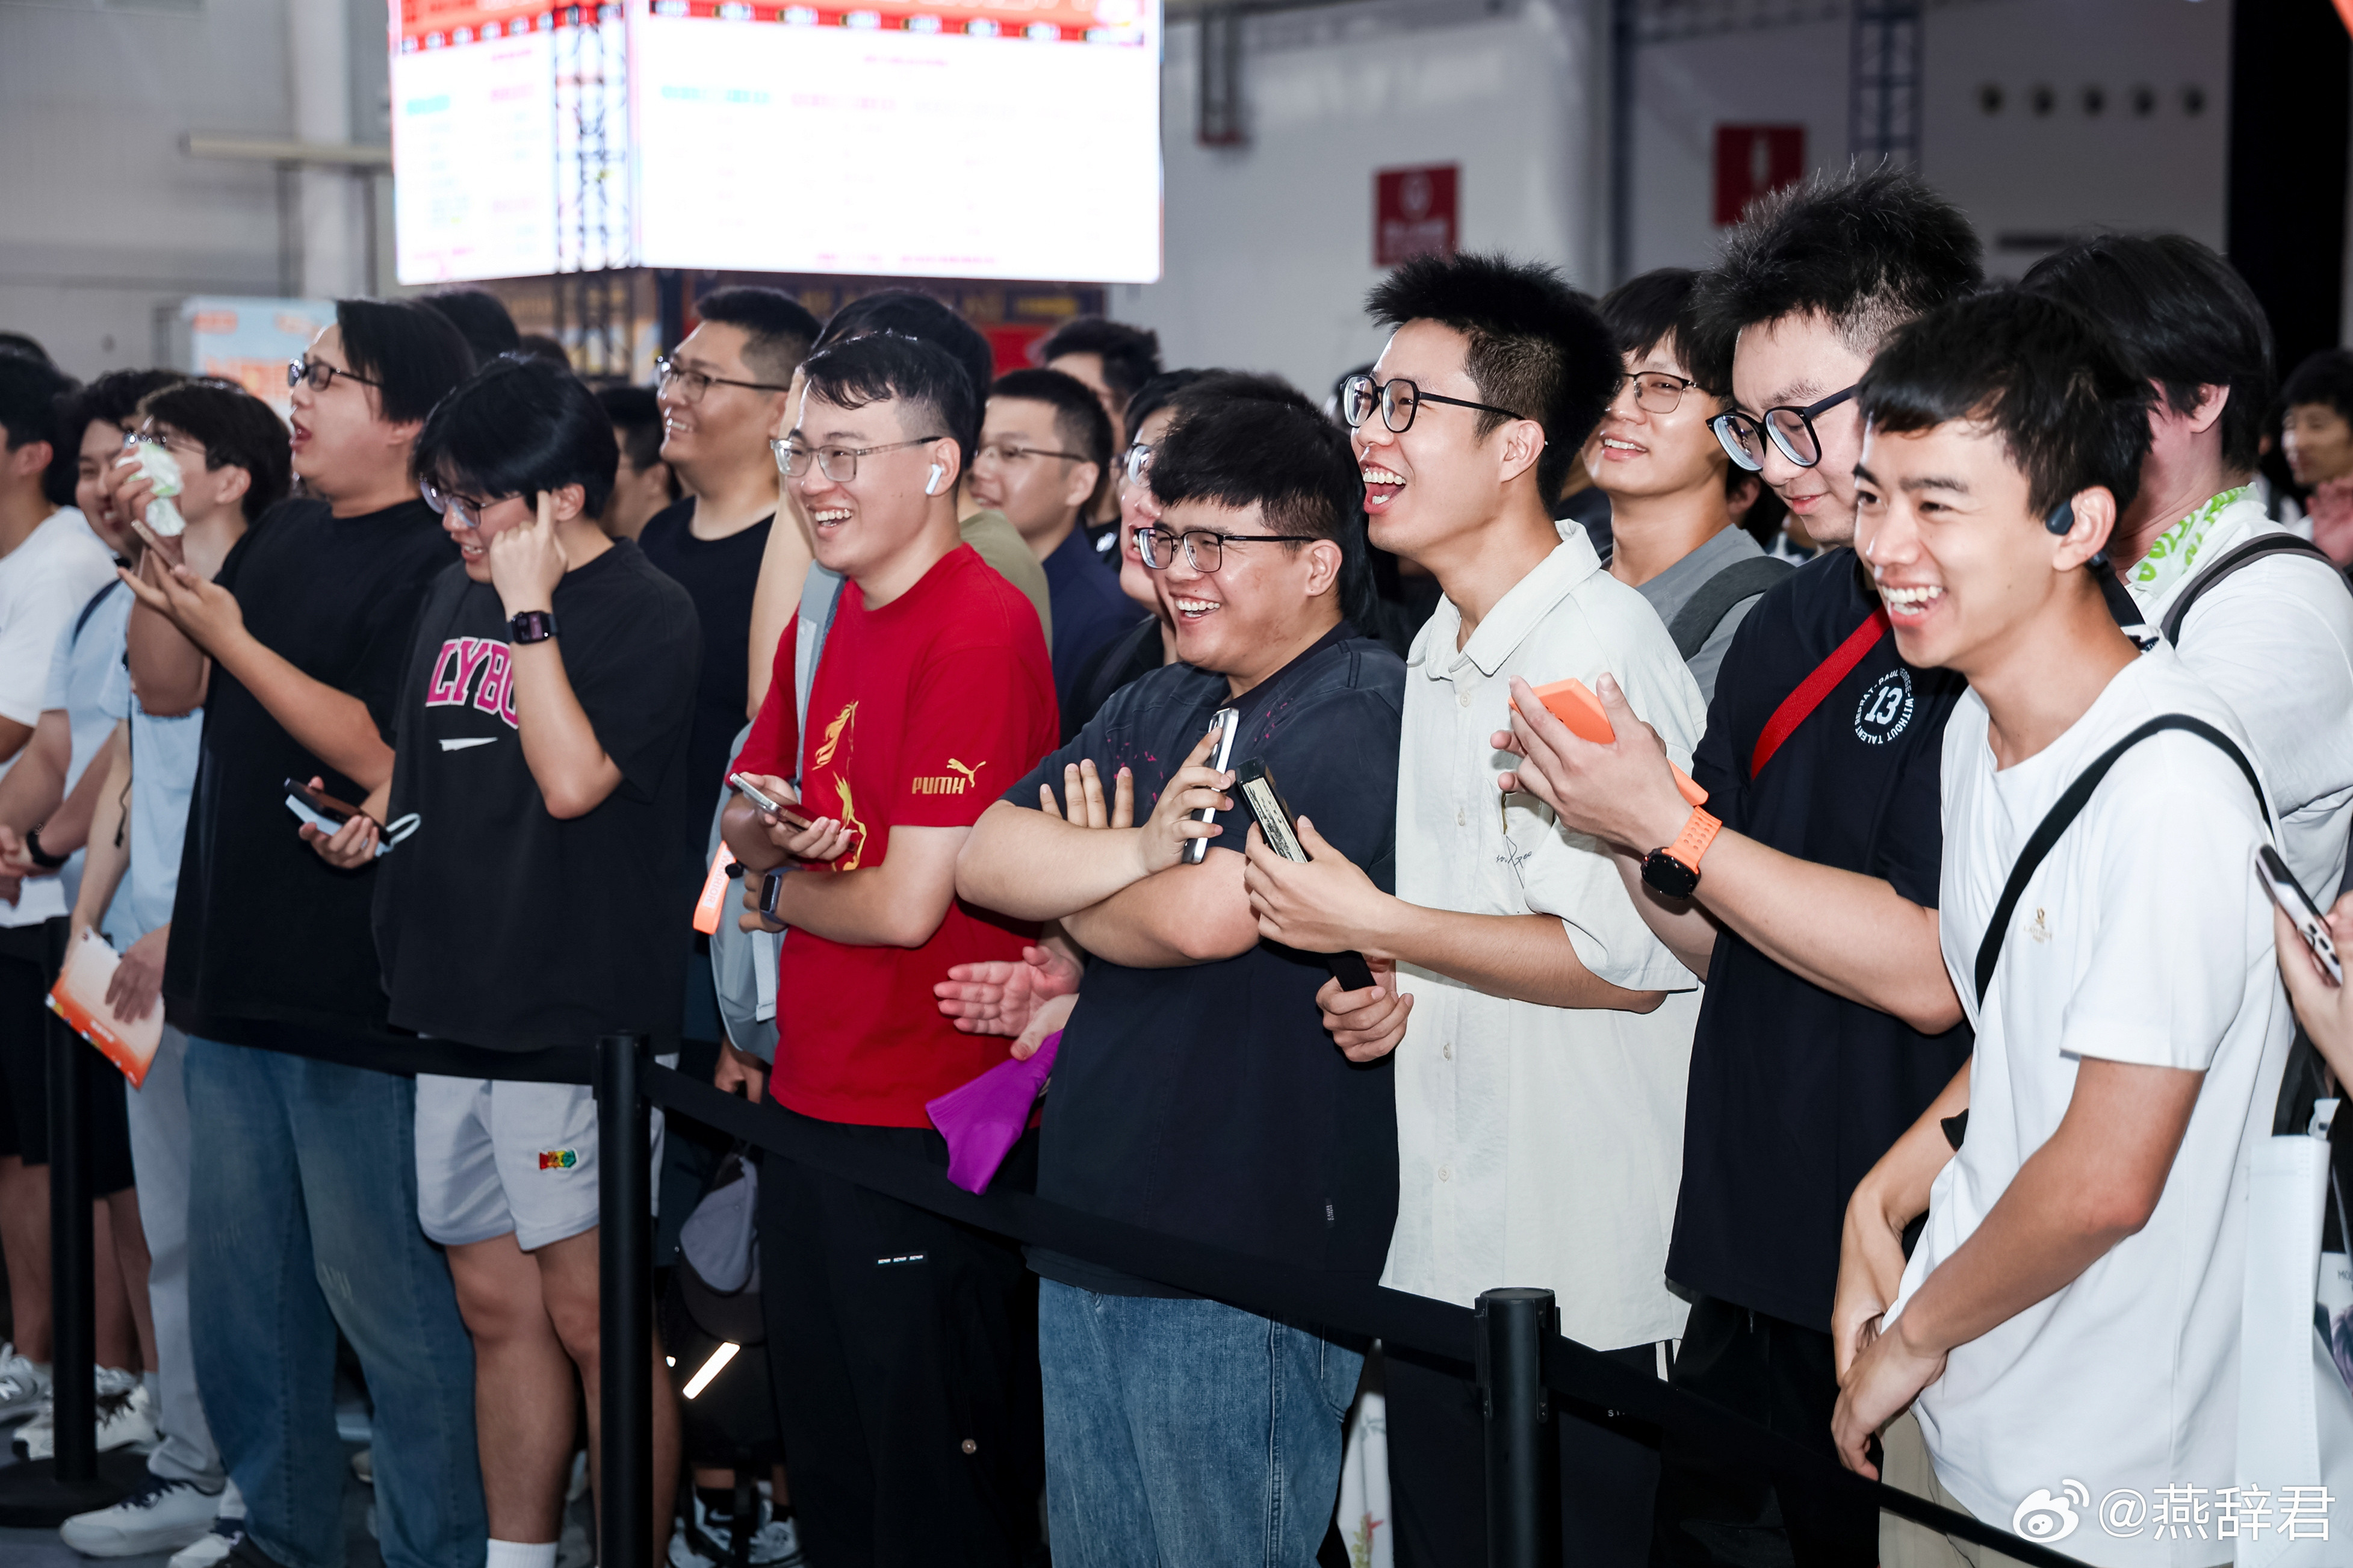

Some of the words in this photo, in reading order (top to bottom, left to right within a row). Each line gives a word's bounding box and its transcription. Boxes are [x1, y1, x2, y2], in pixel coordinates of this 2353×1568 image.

[1878, 669, 1899, 686] PAUL
[1864, 686, 1903, 725] 13
[1886, 698, 1914, 742] WITHOUT
[1855, 725, 1883, 745] TALENT
[912, 777, 966, 795] PUMA
